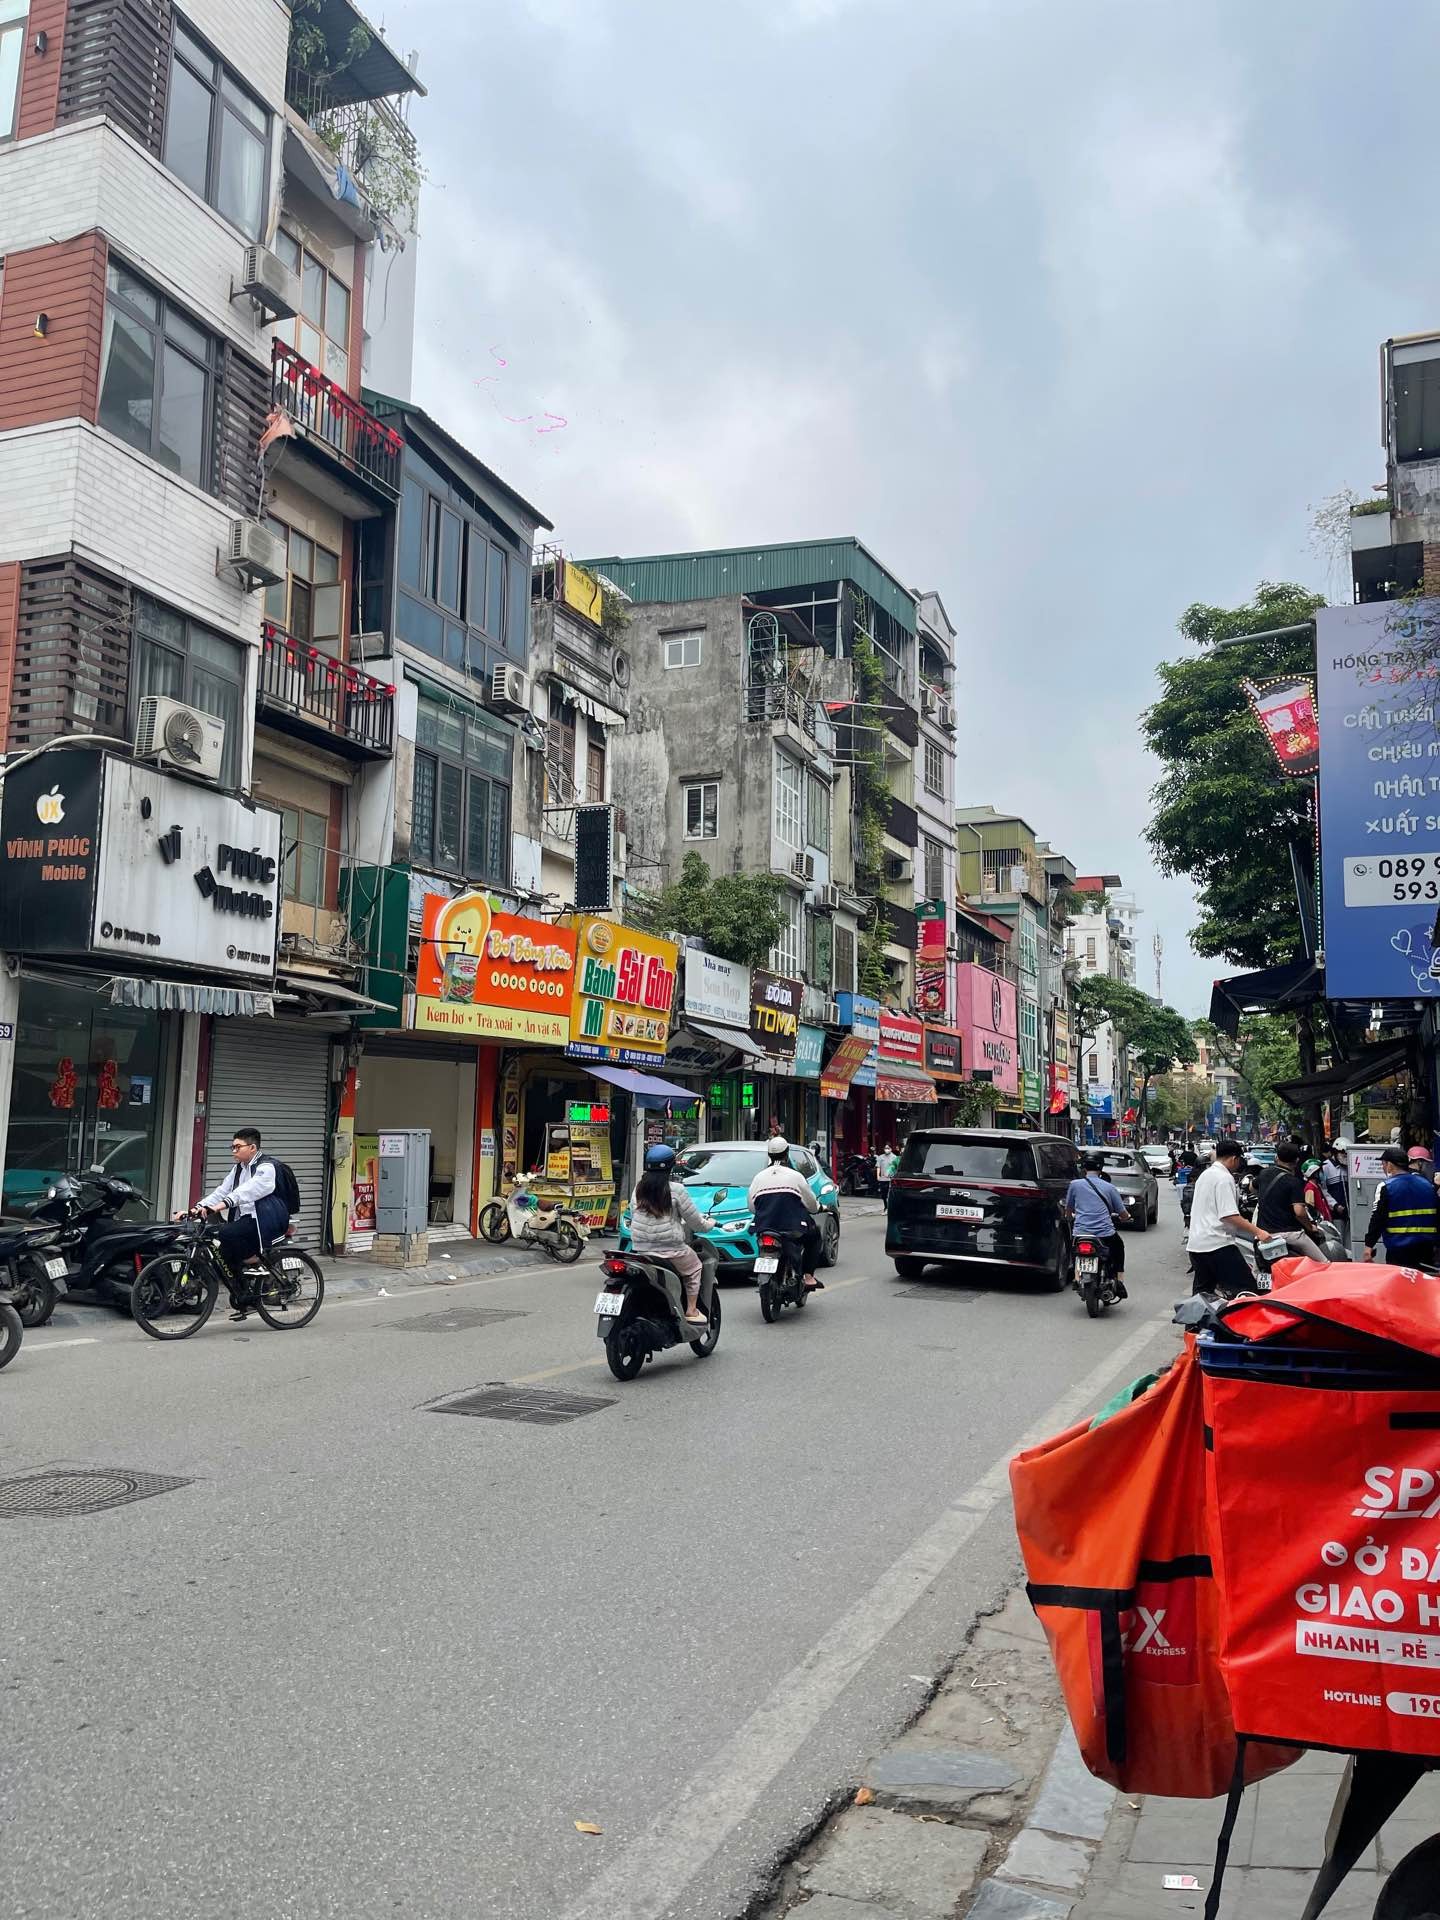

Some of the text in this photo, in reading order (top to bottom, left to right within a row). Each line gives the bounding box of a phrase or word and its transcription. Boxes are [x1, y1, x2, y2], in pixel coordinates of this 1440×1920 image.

[1374, 774, 1426, 798] NHÂN
[1365, 809, 1440, 835] XUẤT S
[7, 834, 90, 859] VĨNH PHÚC
[41, 864, 87, 881] Mobile
[217, 843, 276, 883] PHÚC
[1379, 858, 1425, 878] 089
[1393, 881, 1438, 900] 593
[583, 958, 616, 999] Bánh
[617, 949, 645, 1004] Sài
[644, 956, 674, 1011] Gòn
[427, 1006, 449, 1023] Kem
[1354, 1535, 1389, 1576] Ở
[1295, 1583, 1405, 1623] GIAO
[1146, 1647, 1186, 1656] EXPRESS
[1304, 1631, 1380, 1655] NHANH
[1401, 1638, 1428, 1660] RẺ
[1323, 1690, 1382, 1706] HOTLINE
